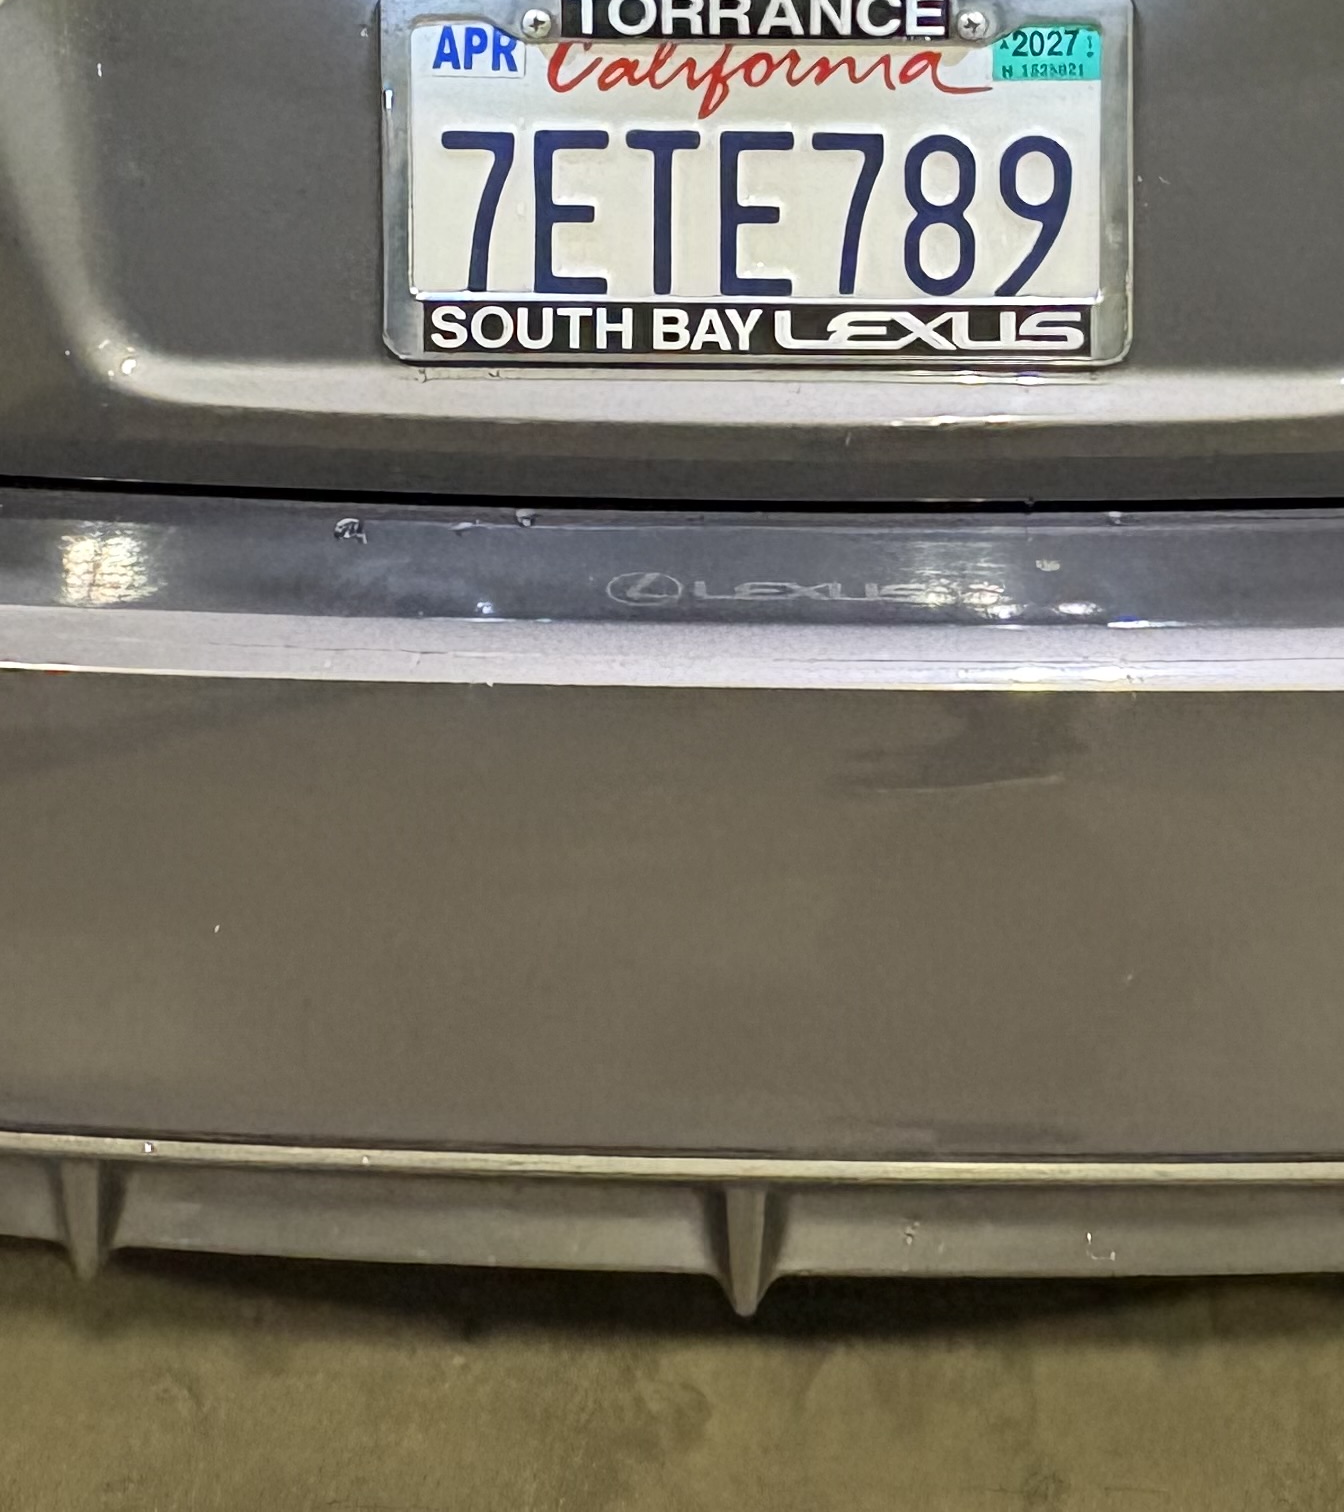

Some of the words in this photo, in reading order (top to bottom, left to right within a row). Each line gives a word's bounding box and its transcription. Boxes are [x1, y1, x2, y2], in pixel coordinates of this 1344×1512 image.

[432, 25, 518, 72] APR
[1012, 29, 1080, 57] 2027
[545, 40, 993, 120] California
[441, 129, 1074, 298] 7ETE789
[430, 305, 633, 352] SOUTH
[652, 305, 763, 352] BAY
[772, 310, 1086, 350] LEXUS
